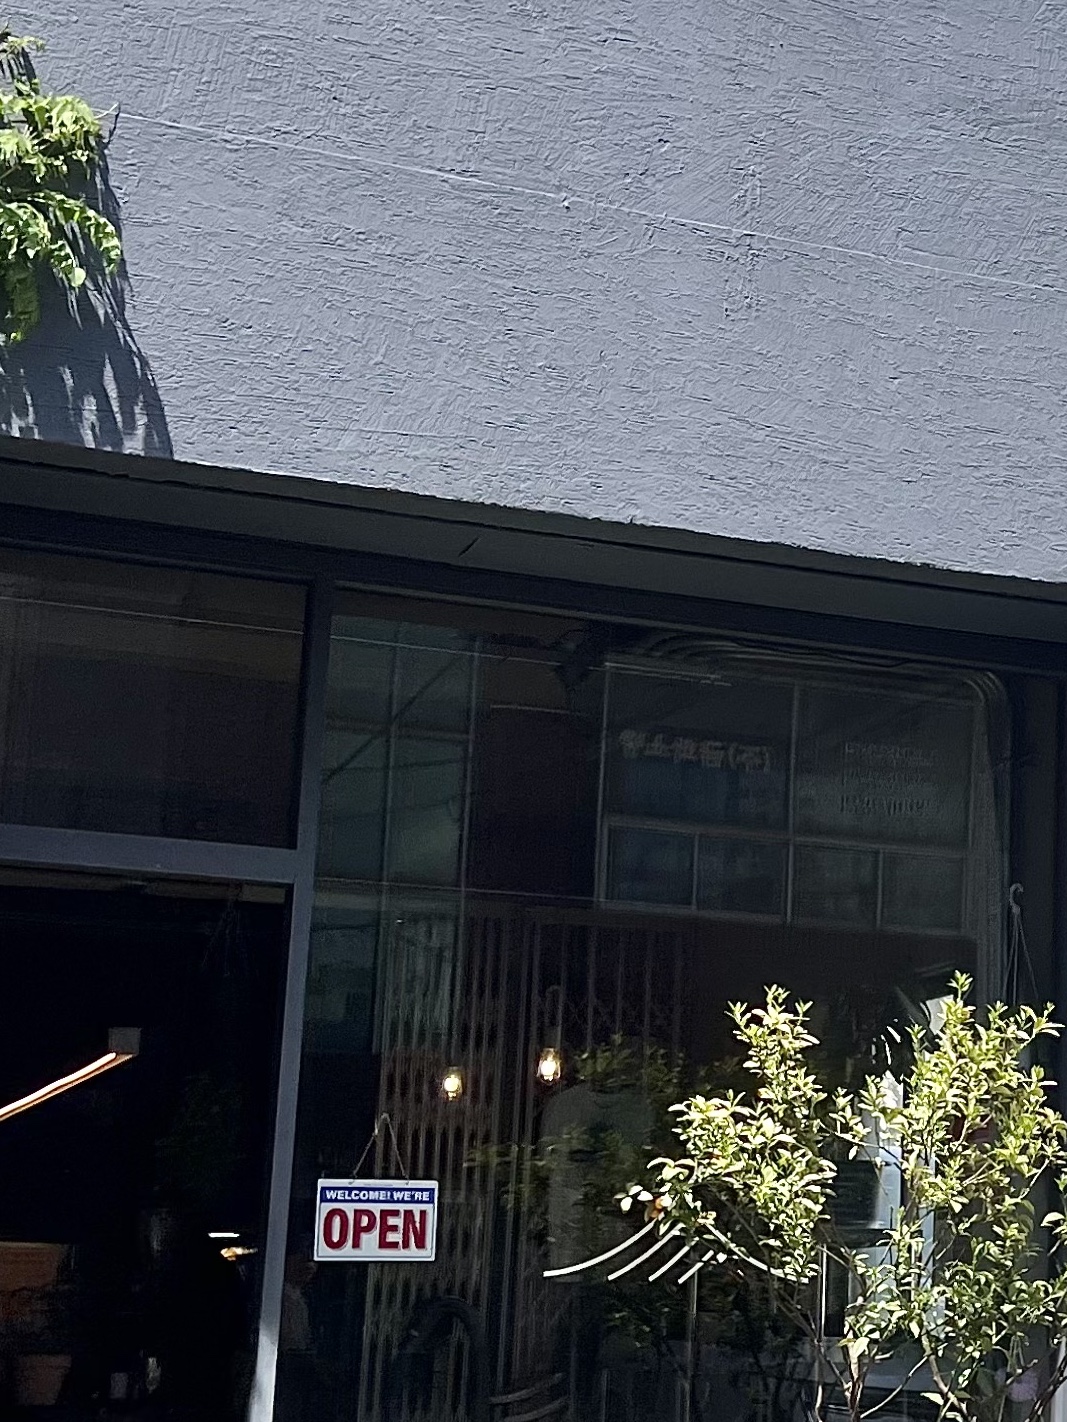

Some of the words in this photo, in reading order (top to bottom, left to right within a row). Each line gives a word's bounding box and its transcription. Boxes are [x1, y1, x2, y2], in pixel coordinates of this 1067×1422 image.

[325, 1190, 390, 1200] WELCOME!
[393, 1191, 430, 1201] WE'RE
[323, 1208, 427, 1250] OPEN
